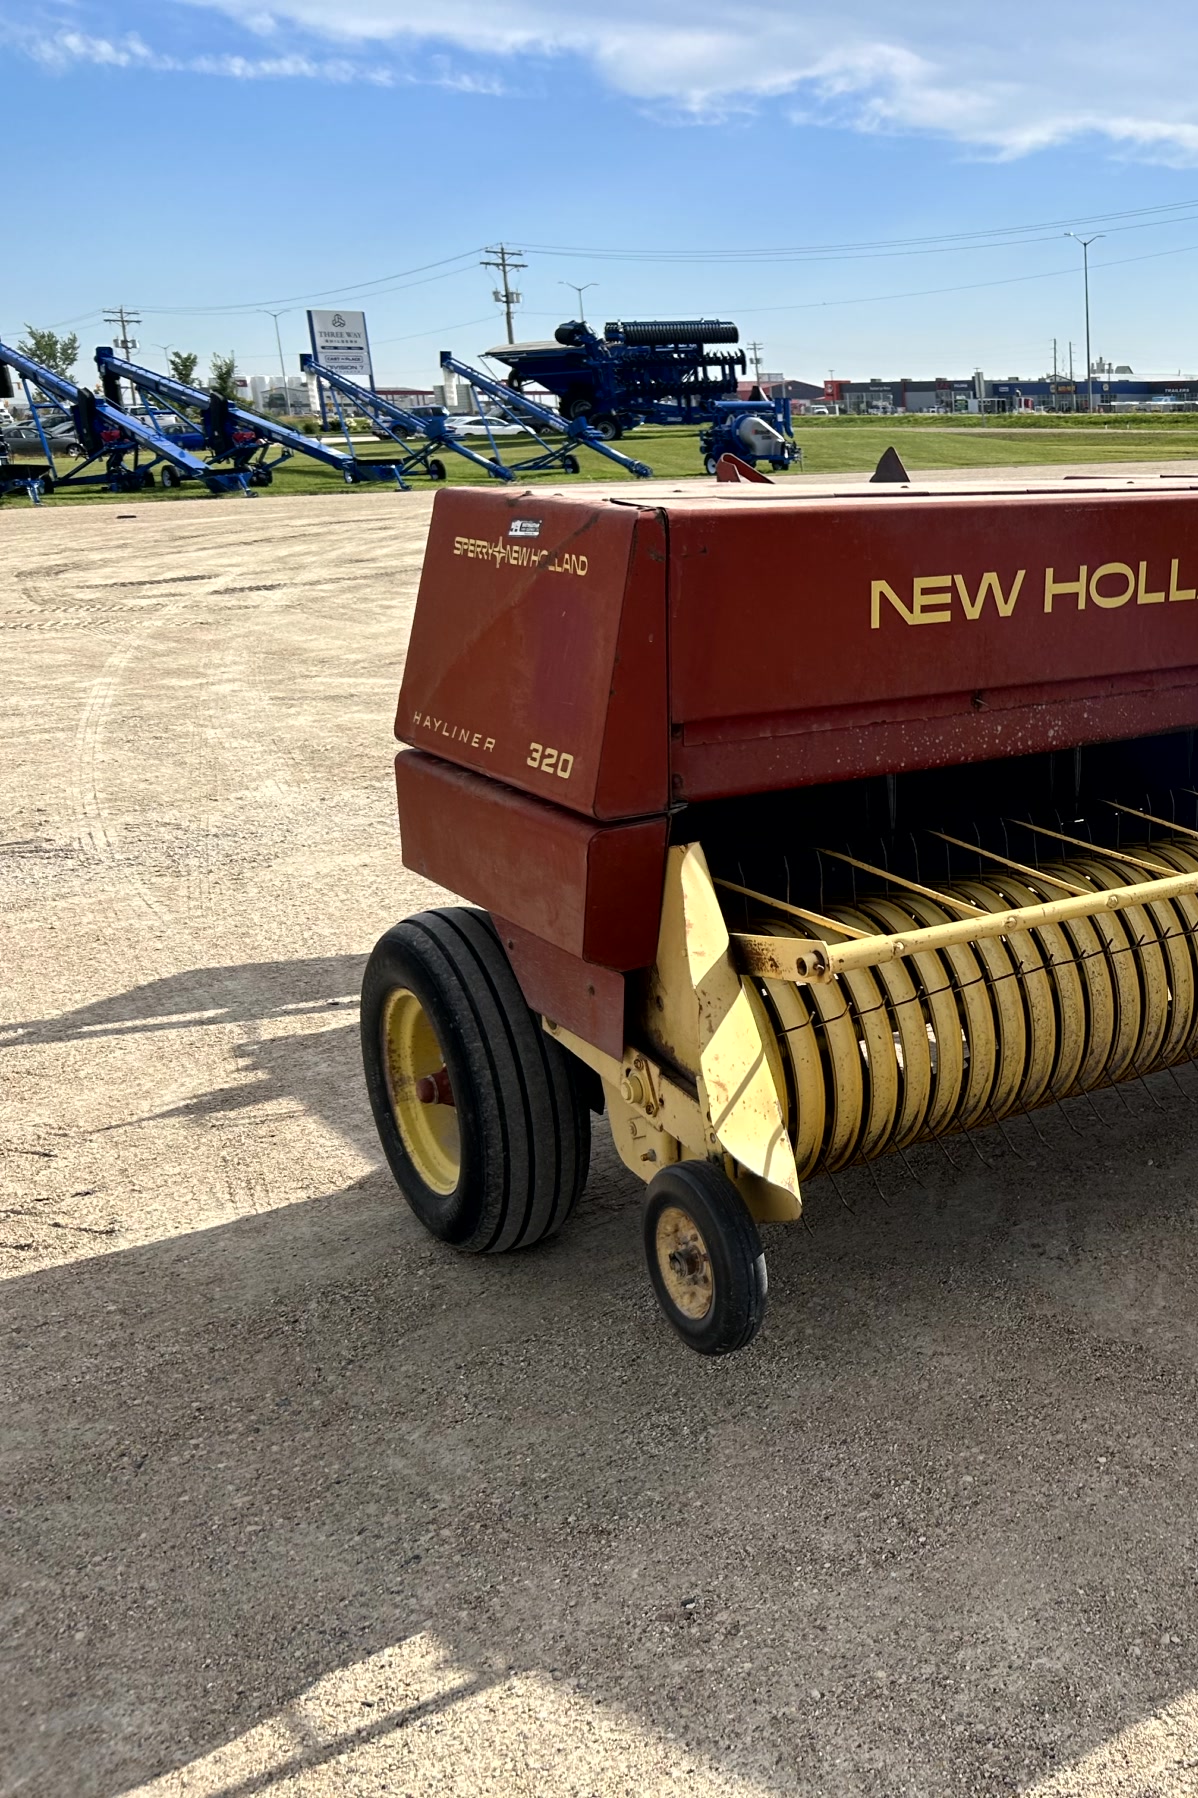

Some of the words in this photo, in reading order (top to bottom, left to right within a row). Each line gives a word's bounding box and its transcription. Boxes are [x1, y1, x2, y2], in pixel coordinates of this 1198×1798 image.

[345, 331, 361, 339] WAY
[453, 536, 495, 560] SPERRY
[505, 544, 530, 567] NEW
[870, 569, 1026, 629] NEW
[413, 711, 496, 752] HAYLINER
[526, 742, 574, 779] 320
